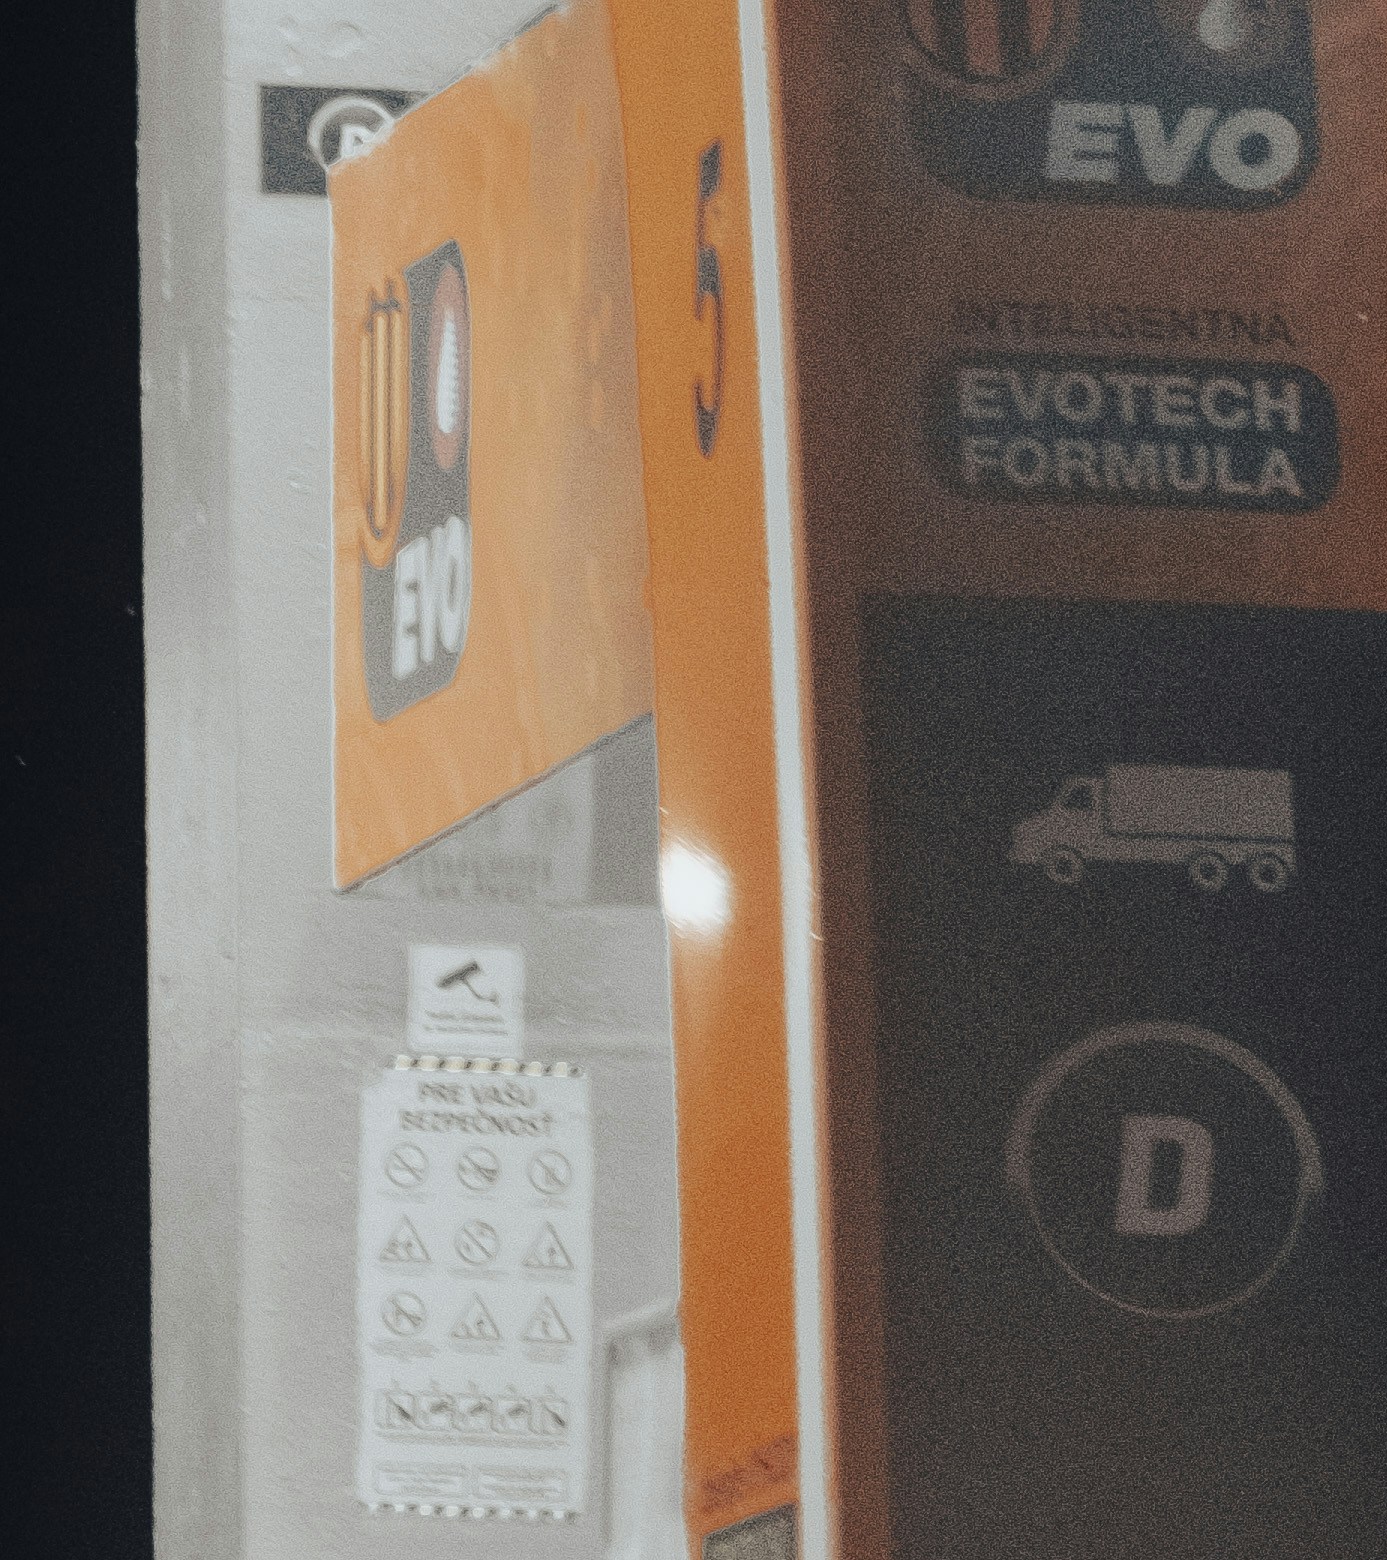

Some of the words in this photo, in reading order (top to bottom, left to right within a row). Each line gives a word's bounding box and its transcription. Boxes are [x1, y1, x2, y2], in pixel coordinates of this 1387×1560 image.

[1043, 101, 1301, 191] EVO
[956, 367, 1301, 432] EVOTECH
[962, 436, 1302, 497] FORMULA
[393, 516, 469, 680] EVO
[1115, 1113, 1214, 1237] D
